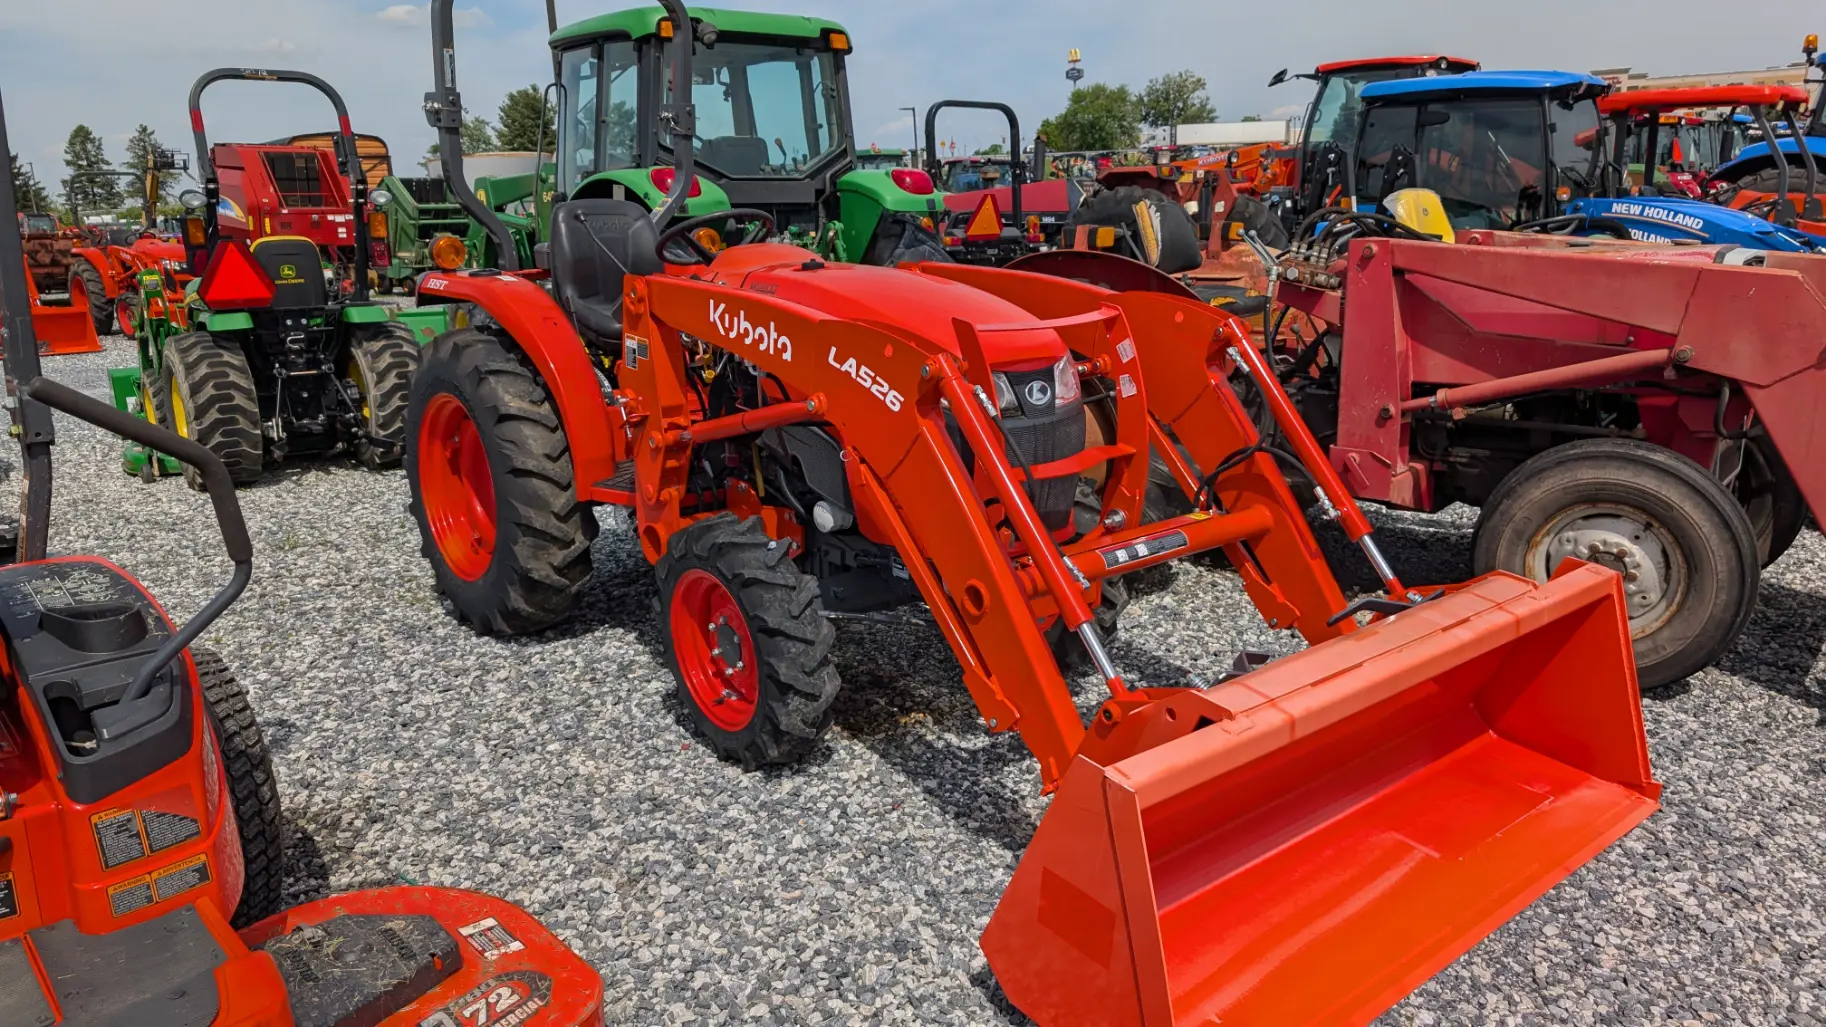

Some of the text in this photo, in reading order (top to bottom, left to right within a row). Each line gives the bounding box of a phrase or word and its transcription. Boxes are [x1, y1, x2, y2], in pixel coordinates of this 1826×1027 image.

[1611, 202, 1704, 230] NEW HOLLAND
[1629, 228, 1673, 244] OLLAND
[427, 278, 449, 290] HST
[709, 299, 792, 362] Kubota
[828, 345, 905, 412] LA526
[462, 986, 521, 1026] 72
